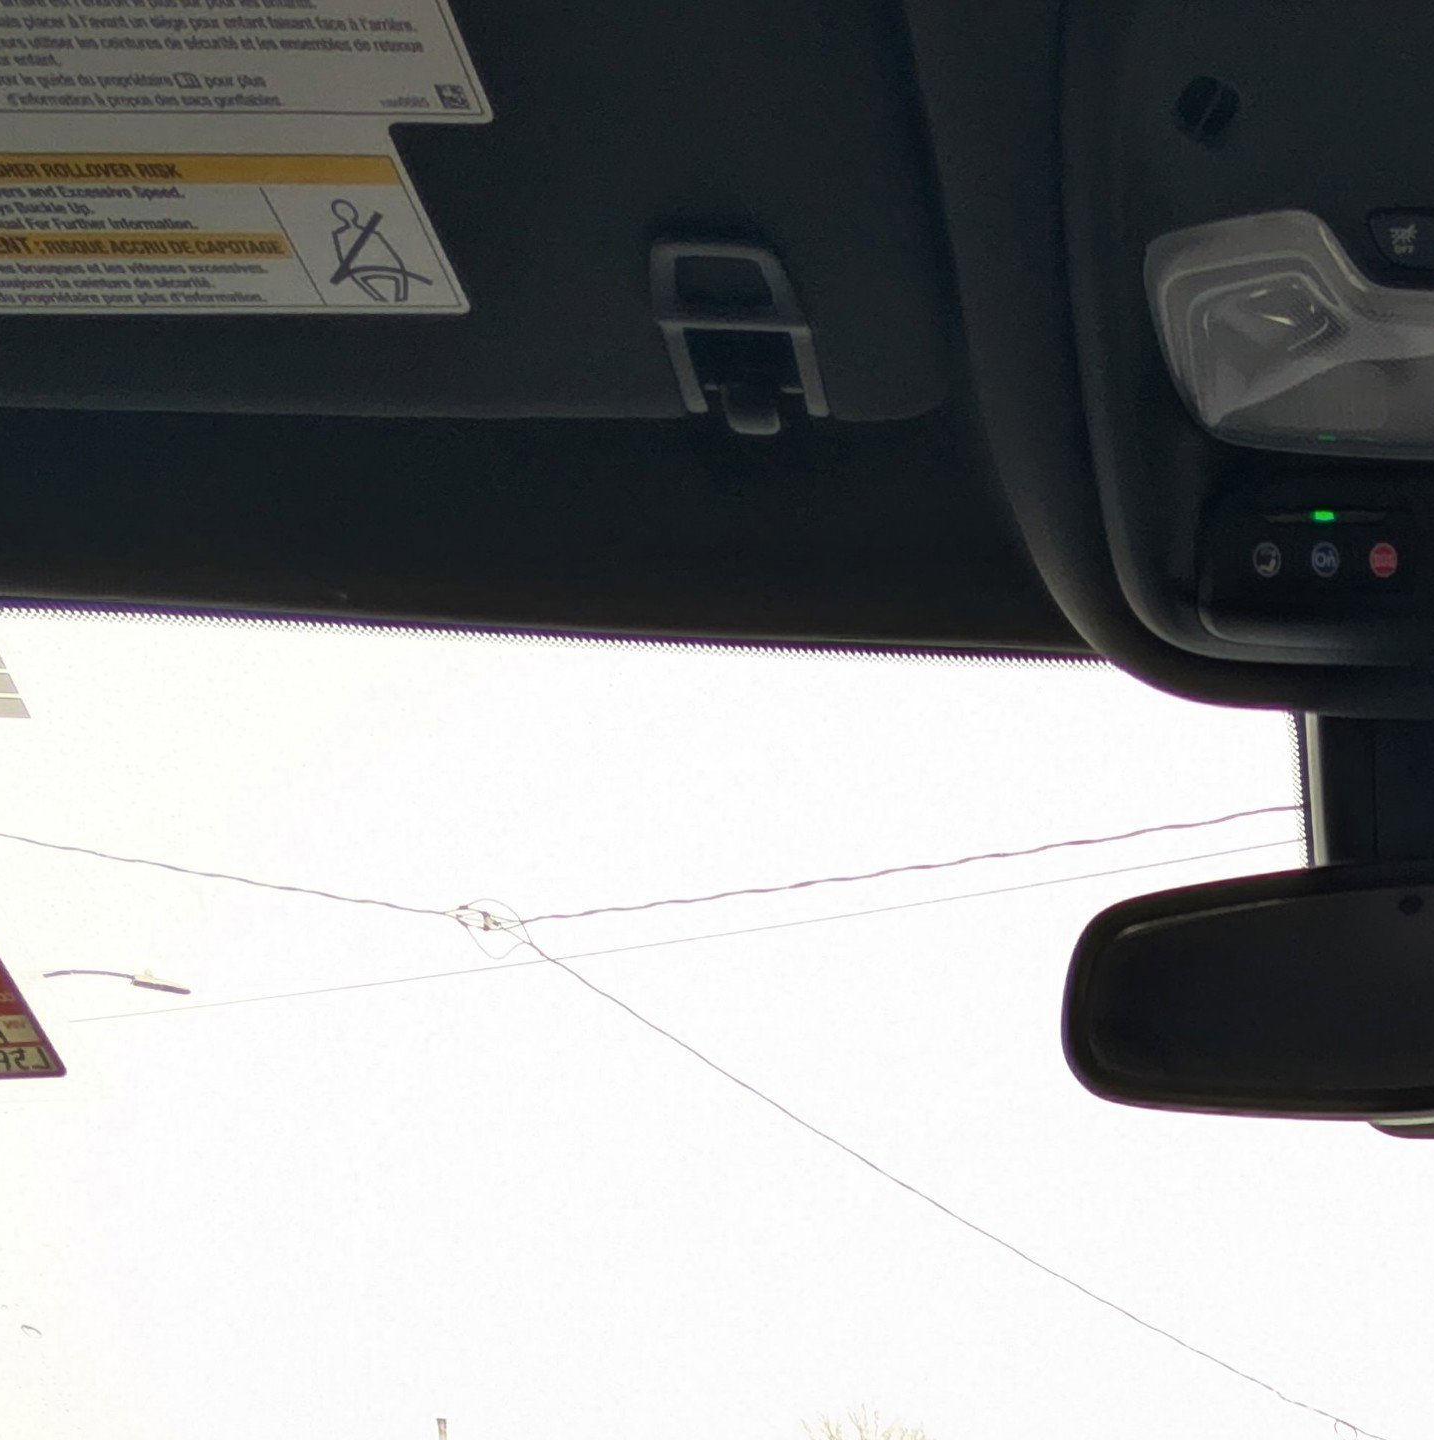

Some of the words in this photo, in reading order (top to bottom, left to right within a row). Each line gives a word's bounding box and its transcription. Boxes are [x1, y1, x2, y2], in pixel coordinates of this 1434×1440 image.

[39, 162, 136, 179] ROLLOVER
[134, 163, 182, 179] RISK
[27, 186, 58, 199] and
[55, 186, 133, 199] Excessive
[132, 186, 186, 200] Speed.
[13, 202, 68, 214] Buckle
[67, 202, 95, 216] Up.
[24, 218, 52, 230] For
[50, 218, 107, 230] Further
[106, 218, 199, 230] Information.
[42, 240, 111, 255] RISQUE
[108, 241, 172, 255] ACCRU
[169, 241, 197, 255] DE
[194, 241, 286, 255] CAPOTAGE
